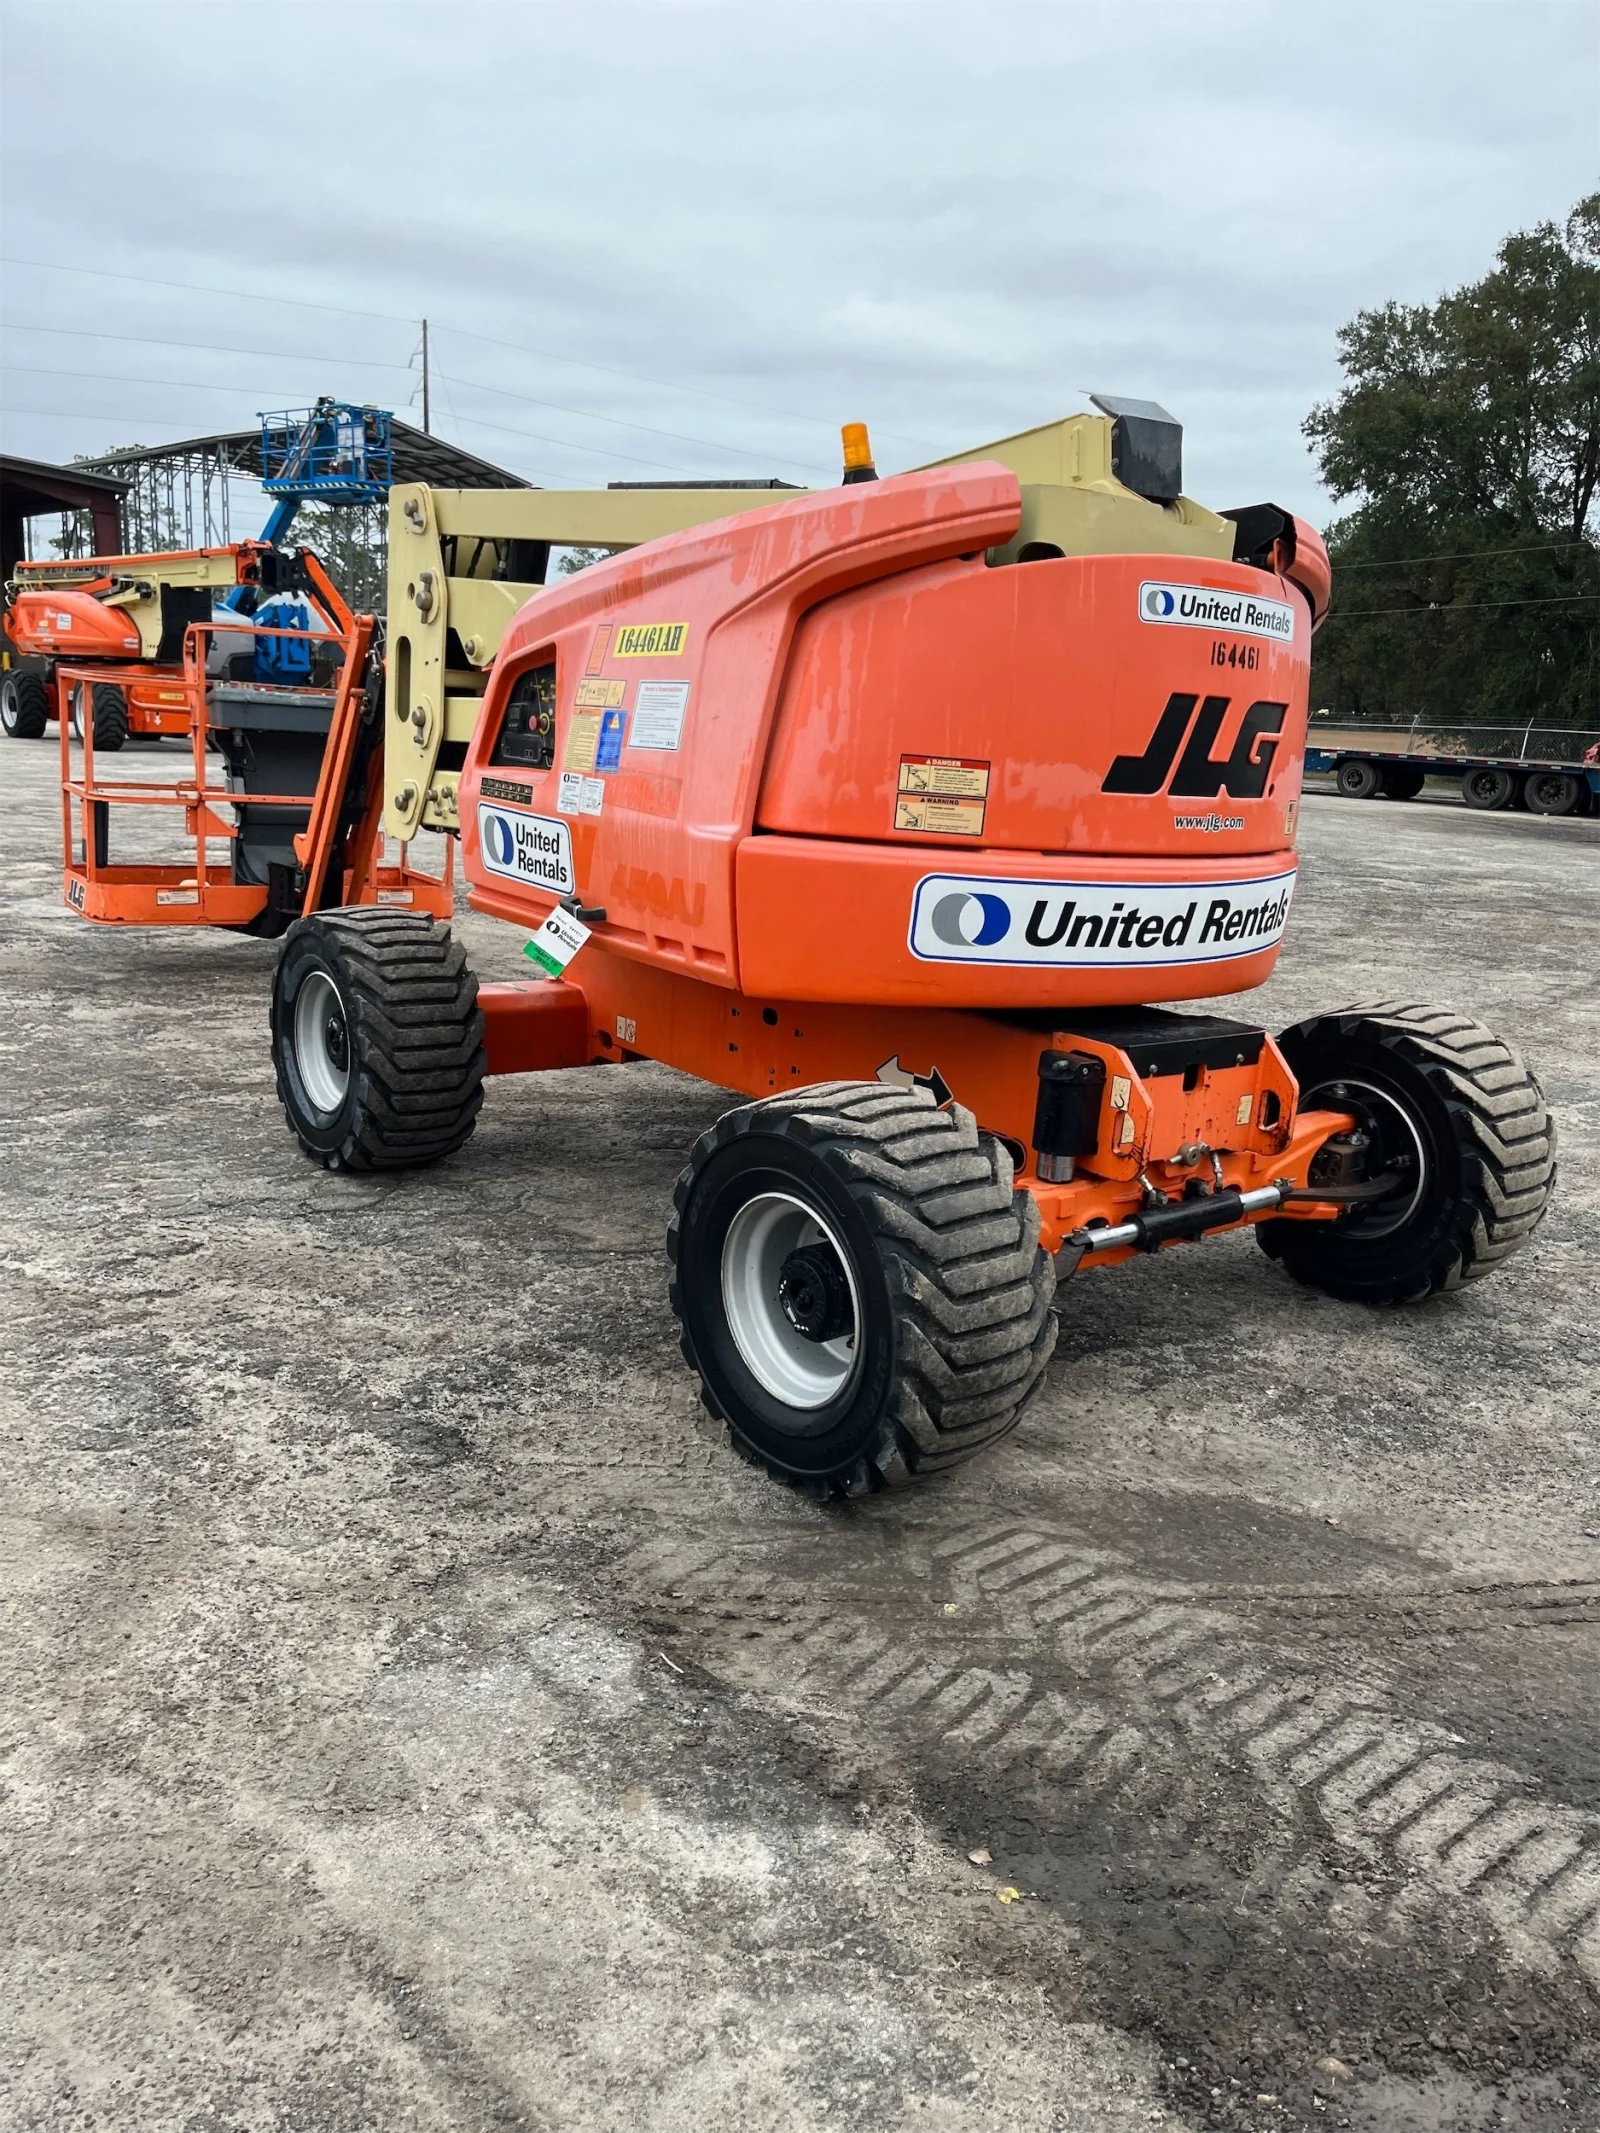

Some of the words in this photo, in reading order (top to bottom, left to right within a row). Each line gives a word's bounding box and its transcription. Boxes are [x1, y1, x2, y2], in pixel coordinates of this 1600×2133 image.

[1180, 594, 1241, 624] United
[1244, 603, 1290, 634] Rentals
[1210, 641, 1260, 671] 164461
[1100, 692, 1289, 799] JLG
[931, 759, 962, 767] DANGER
[926, 797, 960, 806] WARNING
[1174, 813, 1245, 832] www.jlg.com
[515, 822, 561, 855] United
[518, 848, 568, 883] Rentals
[69, 879, 85, 909] JLG
[1025, 899, 1198, 948] United
[1198, 888, 1288, 944] Rentals
